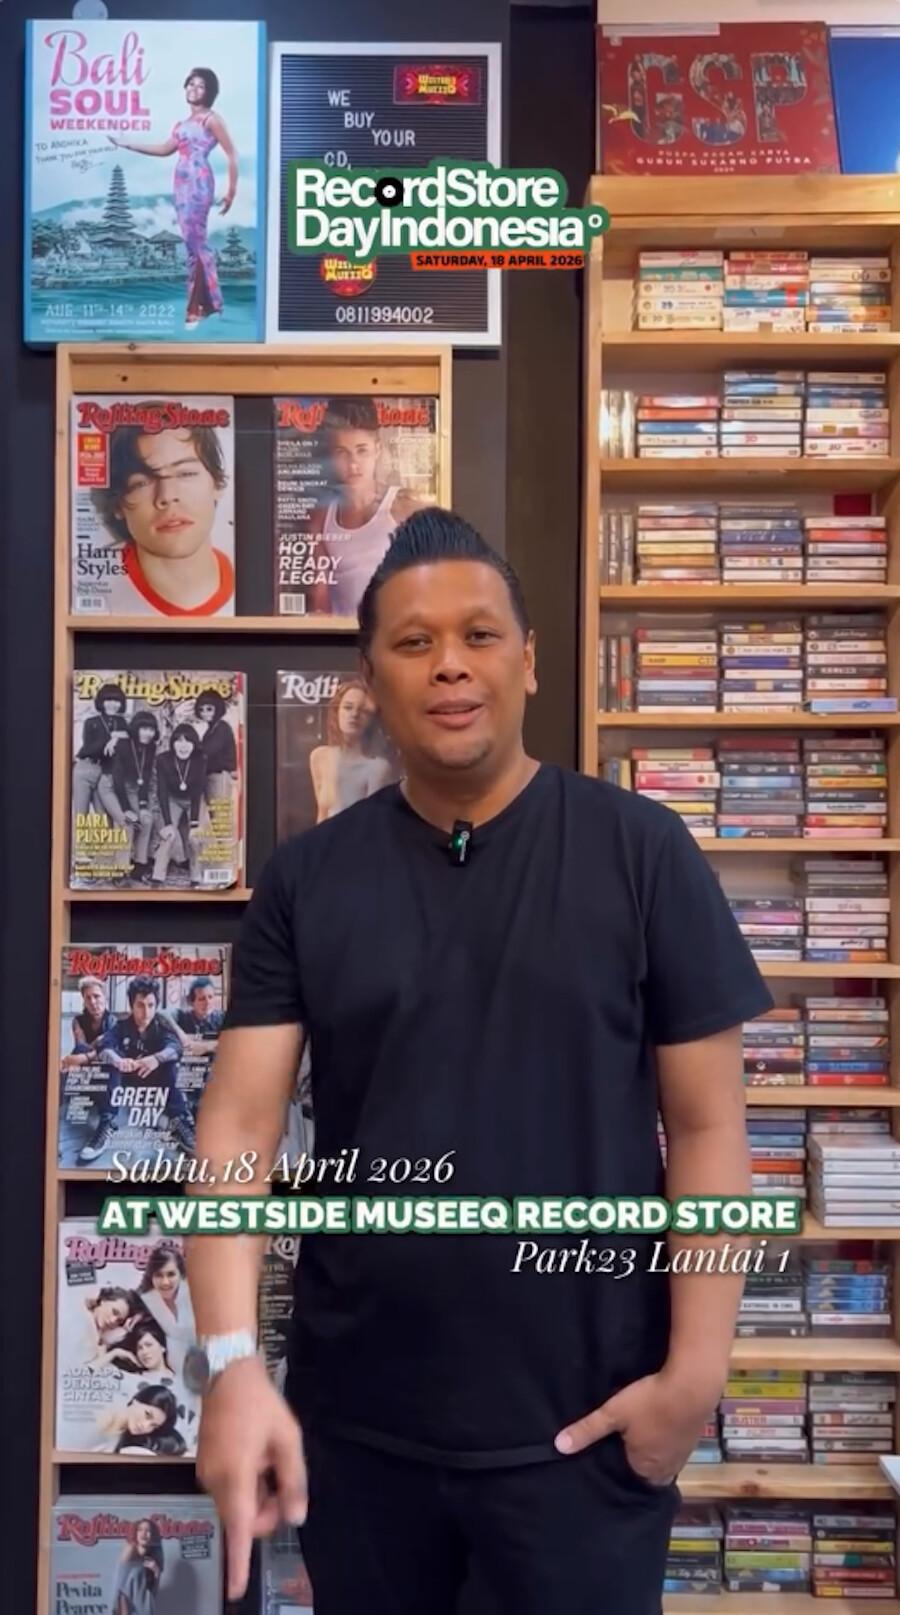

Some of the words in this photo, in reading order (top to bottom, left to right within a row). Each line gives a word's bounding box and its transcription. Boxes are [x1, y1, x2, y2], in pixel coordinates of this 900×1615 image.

[44, 29, 152, 87] Bali
[50, 89, 150, 117] SOUL
[328, 91, 351, 106] WE
[627, 52, 807, 146] GSP
[50, 119, 151, 131] WEEKENDER
[344, 112, 374, 128] BUY
[372, 130, 415, 146] YOUR
[336, 307, 433, 322] 0811994002
[77, 401, 164, 434] Rolling
[163, 401, 230, 427] Stone
[377, 403, 430, 426] tone
[77, 543, 126, 563] Harry
[279, 541, 318, 555] HOT
[77, 559, 129, 580] Styles
[279, 556, 342, 570] READY
[279, 570, 338, 585] LEGAL
[281, 674, 337, 704] Rolli
[76, 813, 108, 828] DARA
[76, 829, 128, 843] PUSPITA
[69, 949, 153, 981] Rolling
[156, 950, 222, 977] Stone
[110, 1086, 169, 1107] GREEN
[128, 1107, 164, 1127] DAY
[62, 1379, 120, 1390] DENGAN
[56, 1581, 102, 1598] Pevita
[56, 1599, 108, 1615] Pearce
